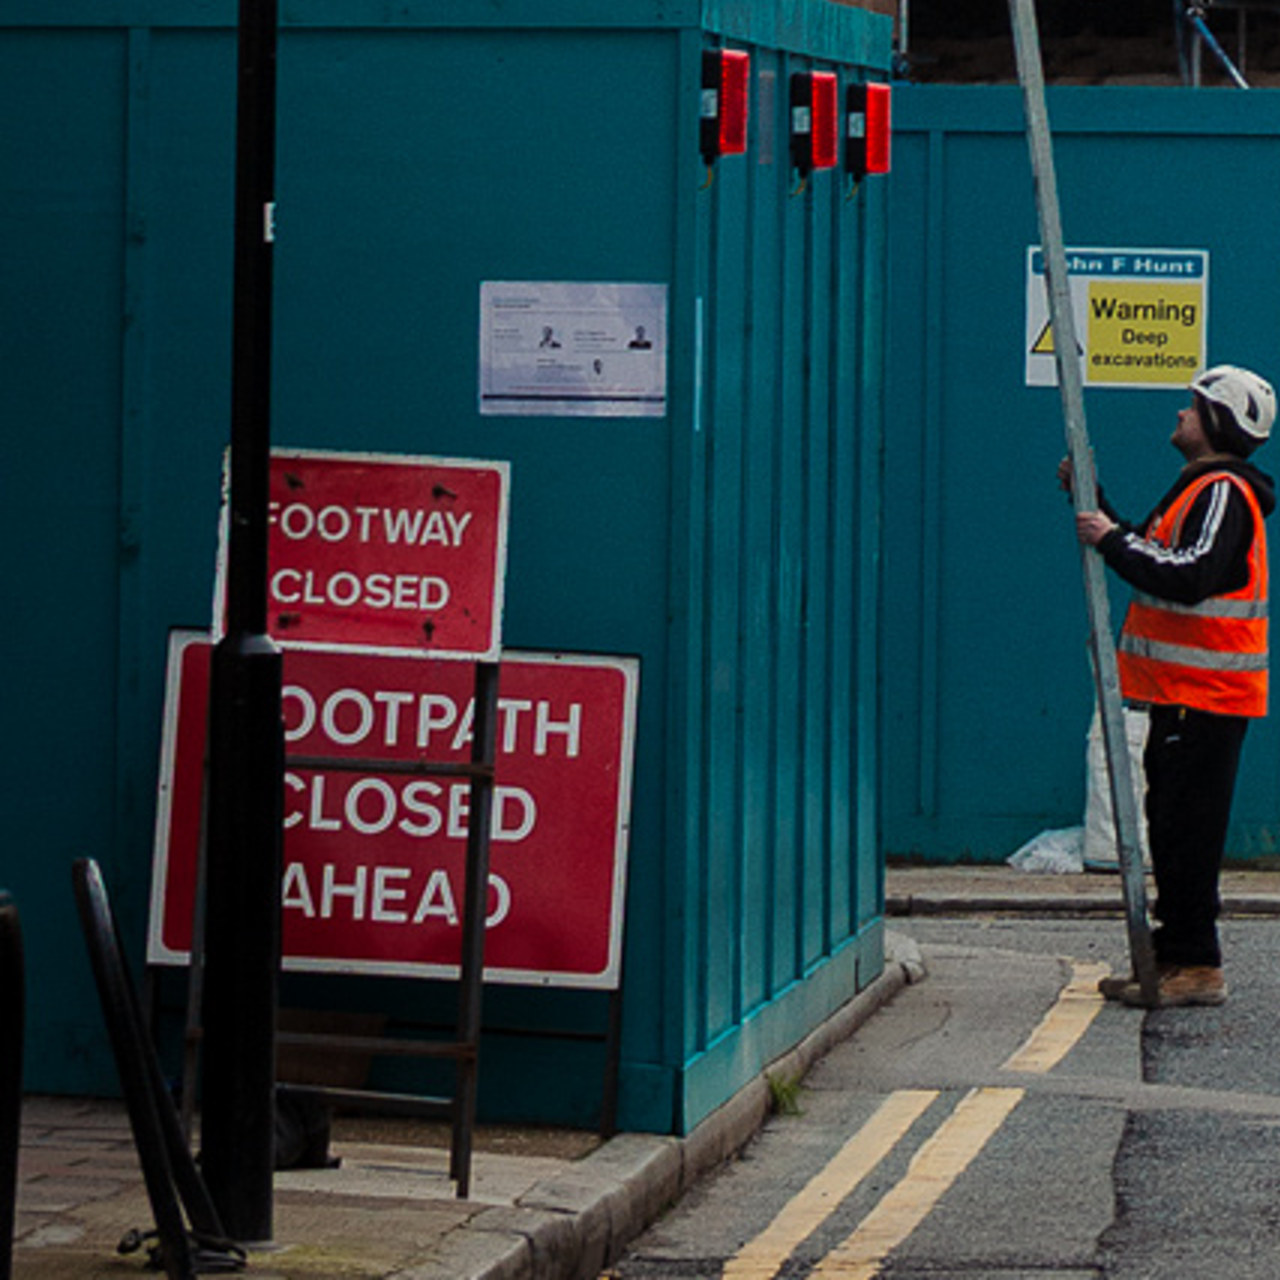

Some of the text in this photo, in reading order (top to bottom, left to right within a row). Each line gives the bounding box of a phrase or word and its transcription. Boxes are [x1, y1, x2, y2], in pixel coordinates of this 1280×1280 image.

[1112, 257, 1126, 271] F
[1133, 257, 1196, 273] Hunt
[1091, 297, 1196, 327] Warning
[1121, 328, 1168, 347] Deep
[1091, 352, 1198, 368] excavations
[271, 568, 450, 611] CLOSED
